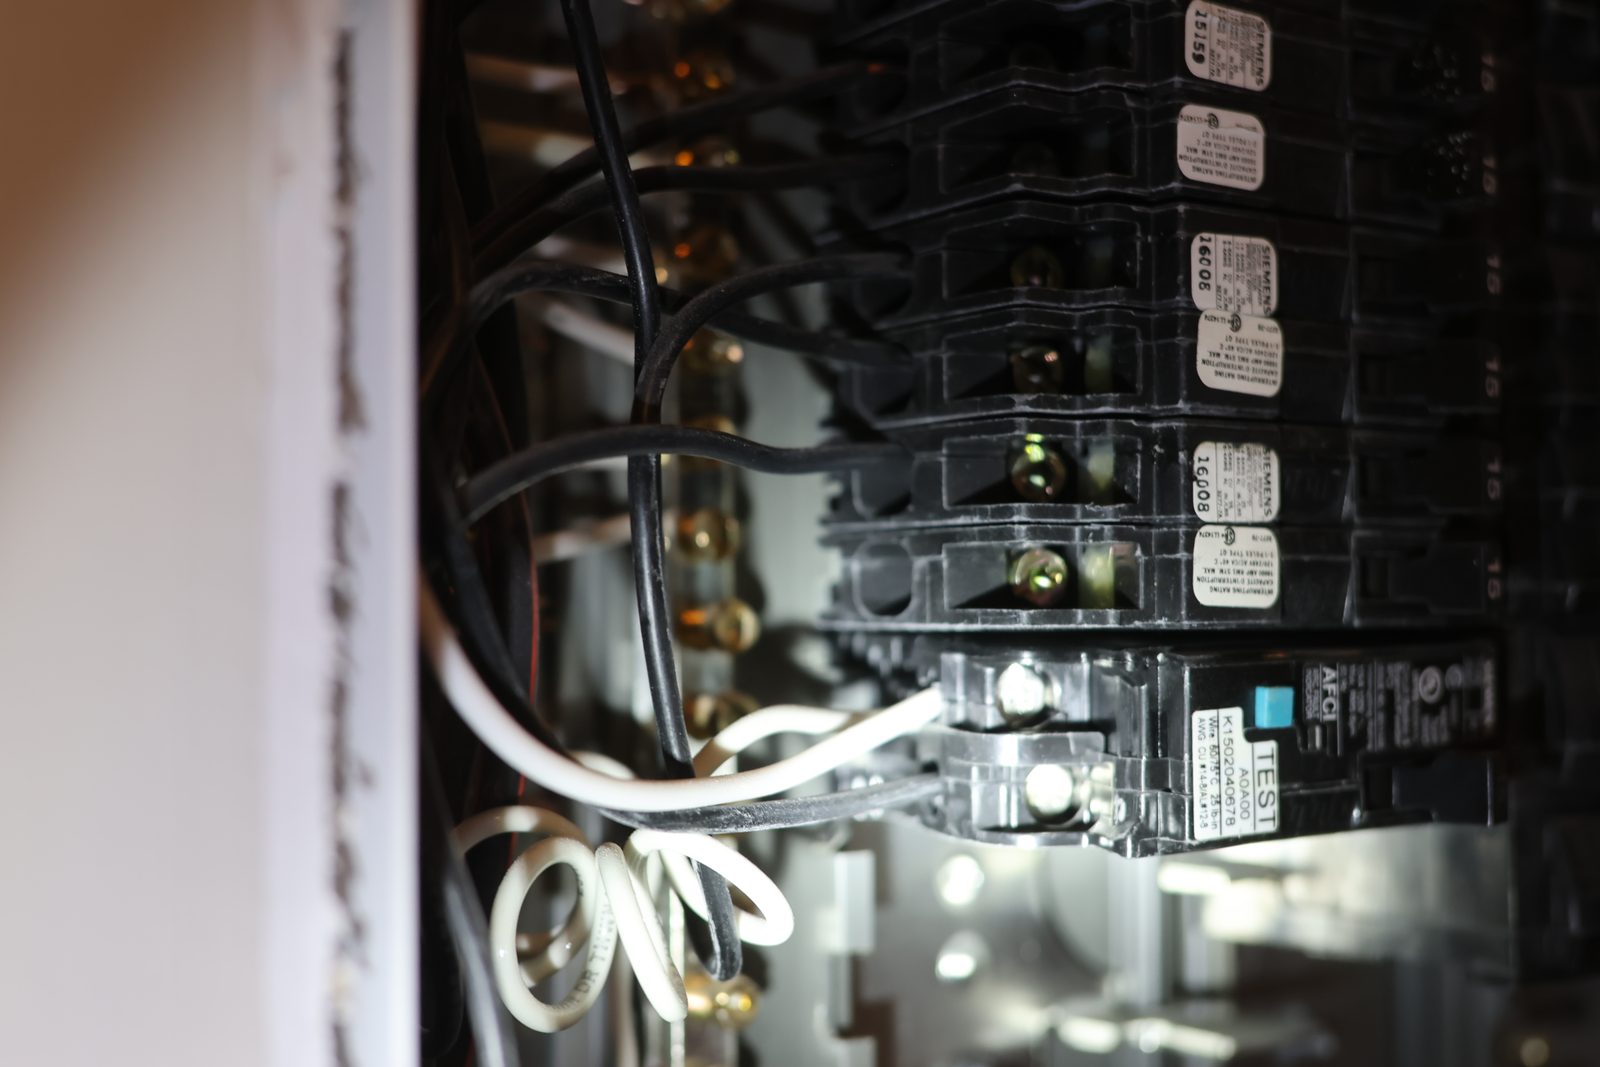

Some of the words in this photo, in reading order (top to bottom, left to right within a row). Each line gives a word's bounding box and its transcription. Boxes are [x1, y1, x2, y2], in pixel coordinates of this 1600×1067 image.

[1192, 10, 1208, 64] 15159
[1199, 236, 1212, 291] 16008
[1263, 245, 1272, 316] SIEMENS
[1214, 370, 1235, 379] RATING
[1197, 456, 1210, 512] 16008
[1263, 447, 1272, 516] SIEMENS
[1487, 458, 1501, 500] 15
[1232, 587, 1273, 595] INTERRUPTING
[1487, 560, 1501, 600] 15
[1322, 667, 1337, 721] AFCI
[1198, 718, 1207, 741] AWG
[1208, 716, 1219, 738] Wire
[1198, 746, 1206, 760] CU
[1209, 794, 1220, 806] 25
[1257, 747, 1276, 829] TEST
